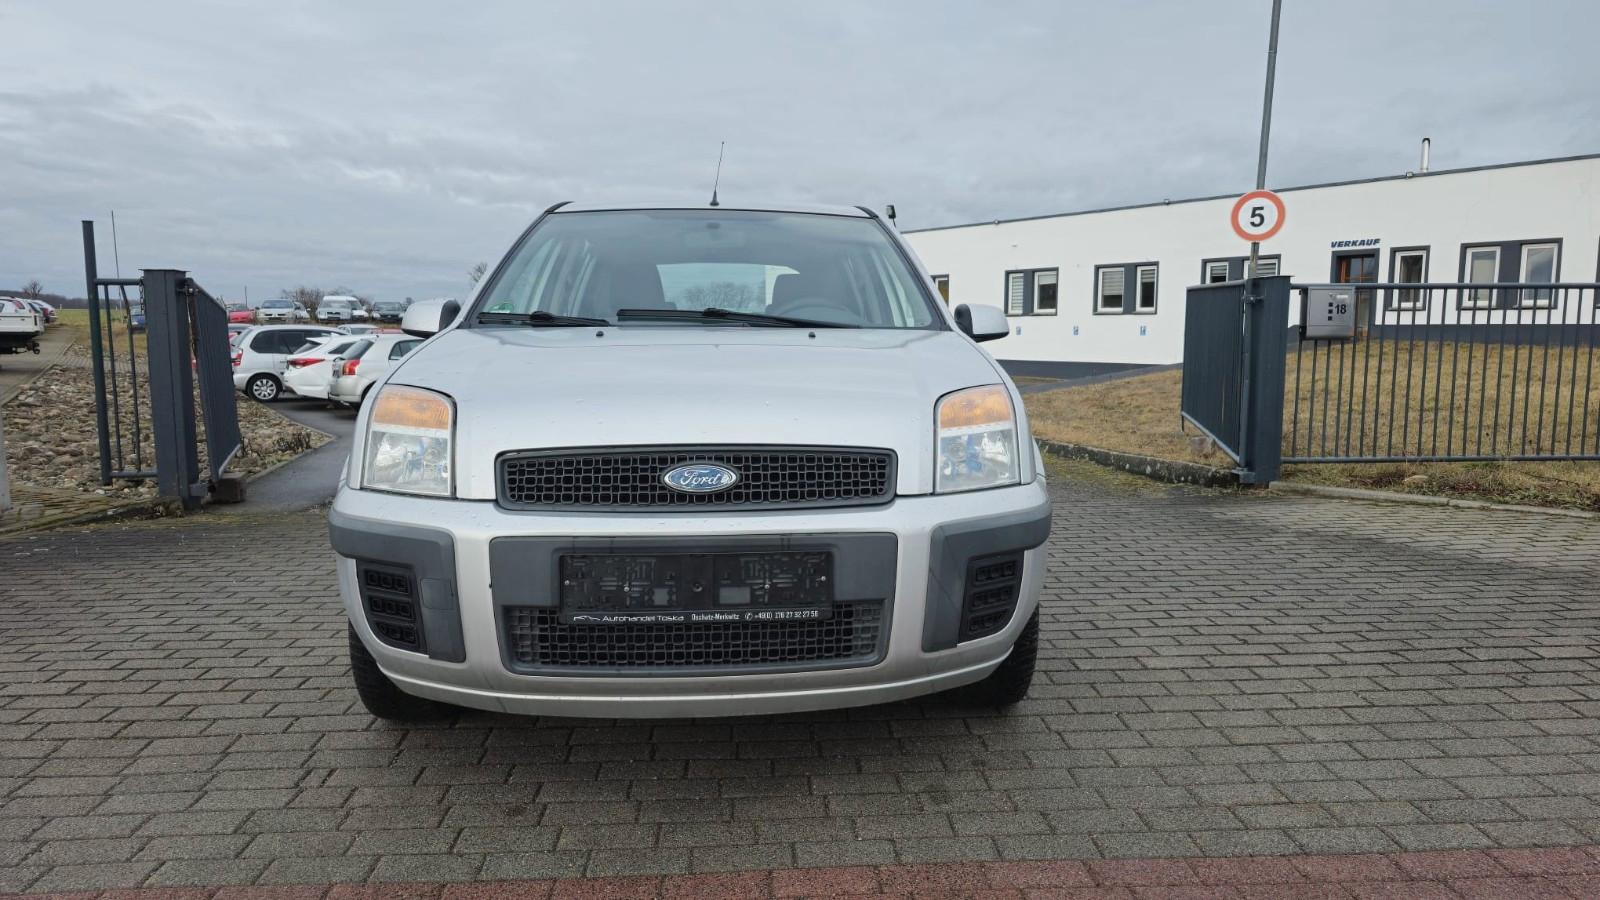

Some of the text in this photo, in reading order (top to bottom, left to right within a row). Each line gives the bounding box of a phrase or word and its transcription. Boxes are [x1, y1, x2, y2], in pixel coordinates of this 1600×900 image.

[1250, 206, 1264, 227] 5
[1331, 238, 1381, 248] VERKAUF
[1335, 304, 1347, 315] 18
[680, 470, 721, 485] Ford
